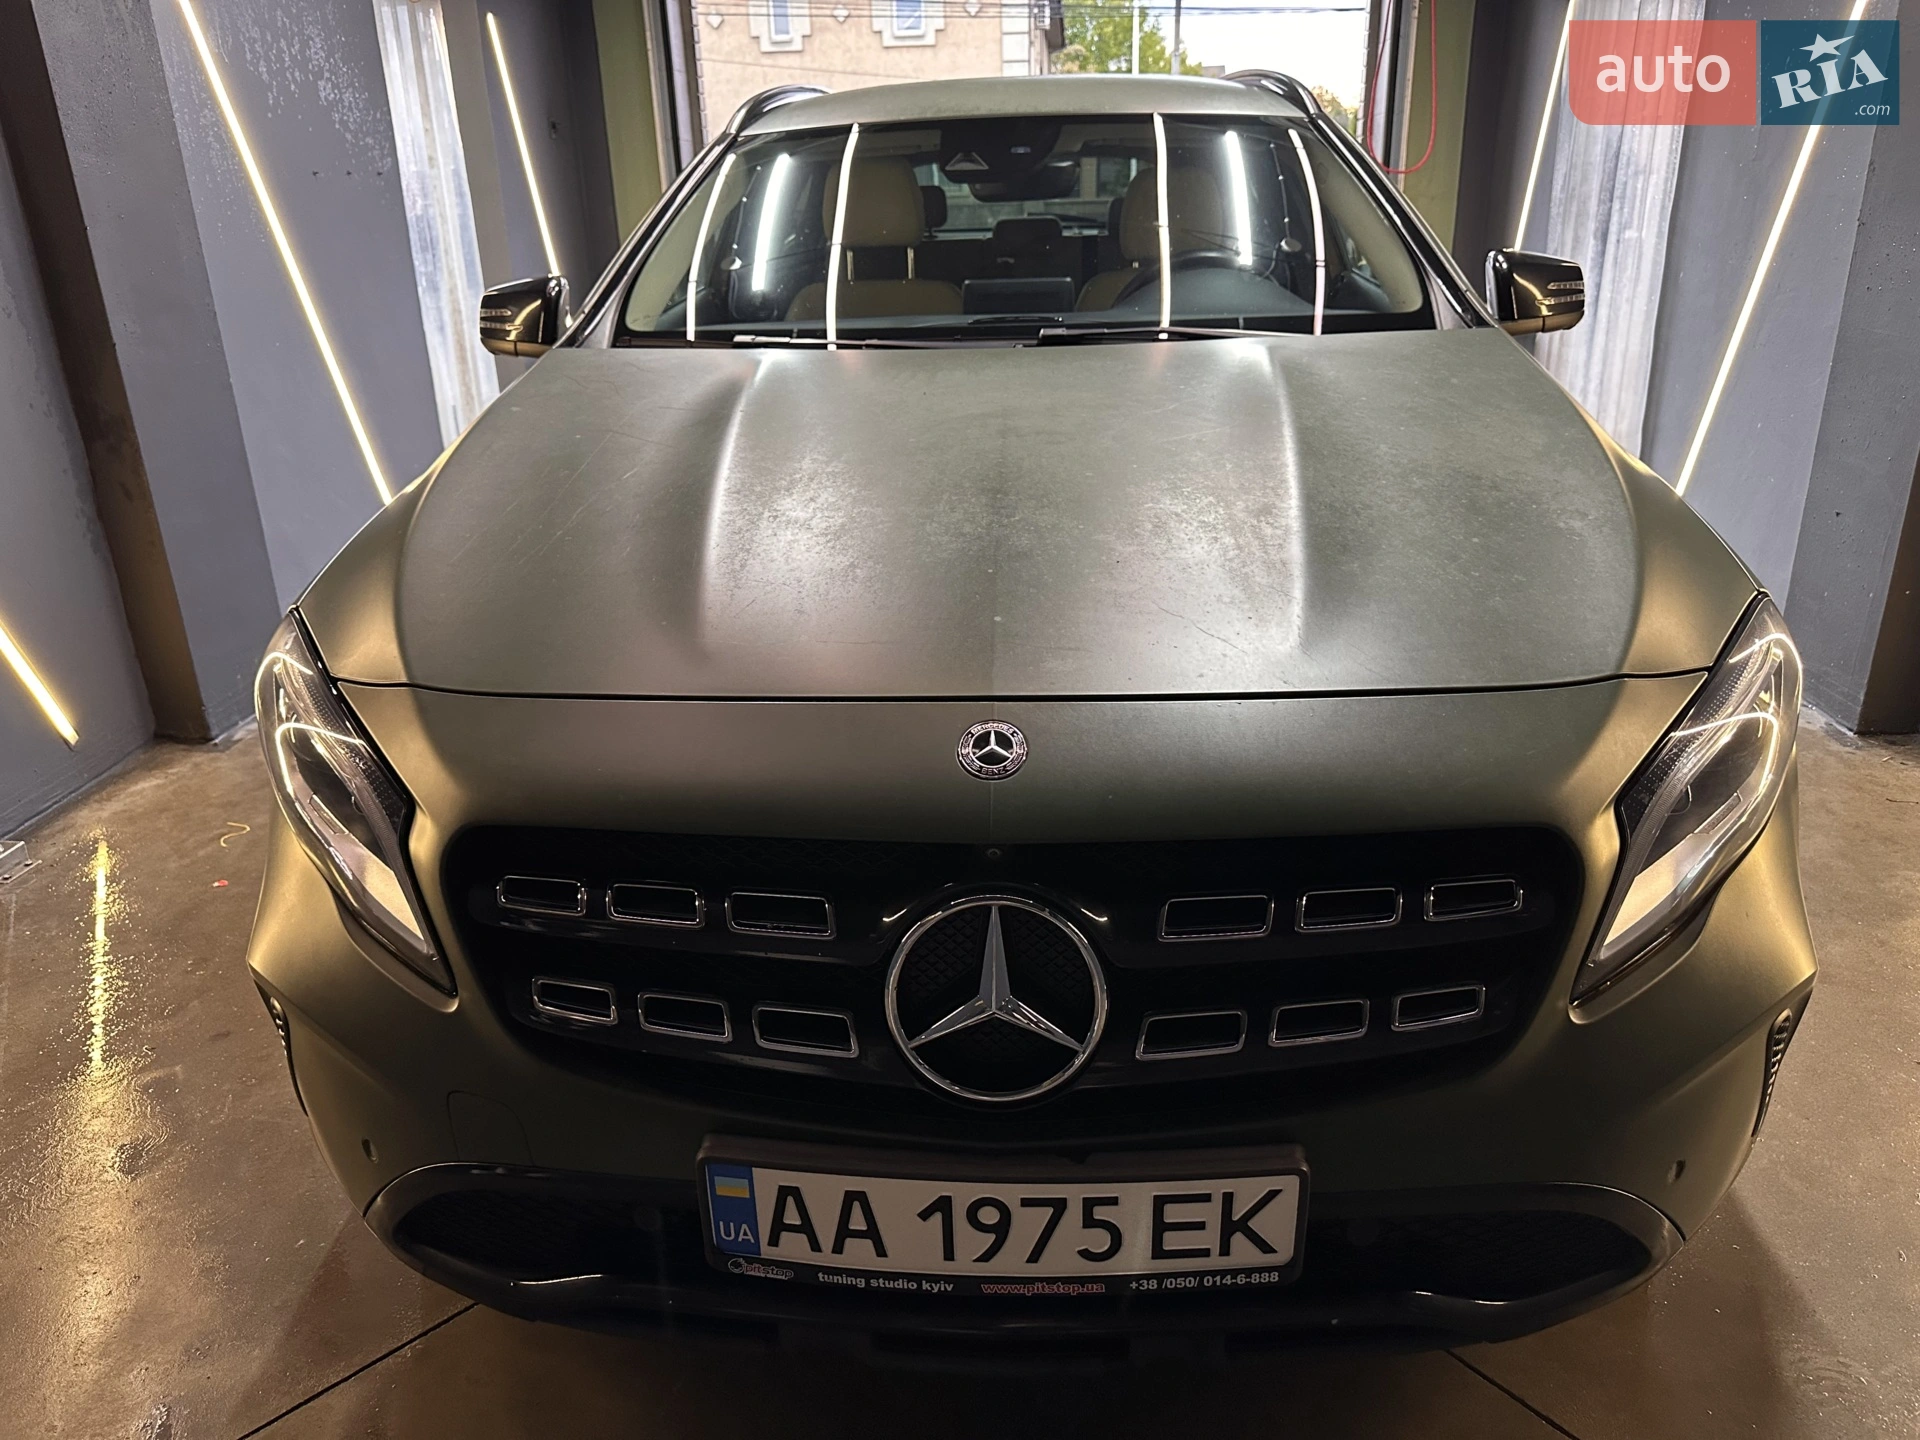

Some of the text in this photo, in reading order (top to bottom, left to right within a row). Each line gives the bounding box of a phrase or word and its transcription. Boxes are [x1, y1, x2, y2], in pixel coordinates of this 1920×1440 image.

[719, 1220, 755, 1243] UA
[767, 1184, 1284, 1263] AA 1975 EK
[744, 1263, 794, 1279] pitstop
[818, 1271, 954, 1293] tuning studio kyiv
[981, 1281, 1105, 1295] www.pitstop.ua
[1129, 1272, 1279, 1291] +38 /050/ 014-6-888
